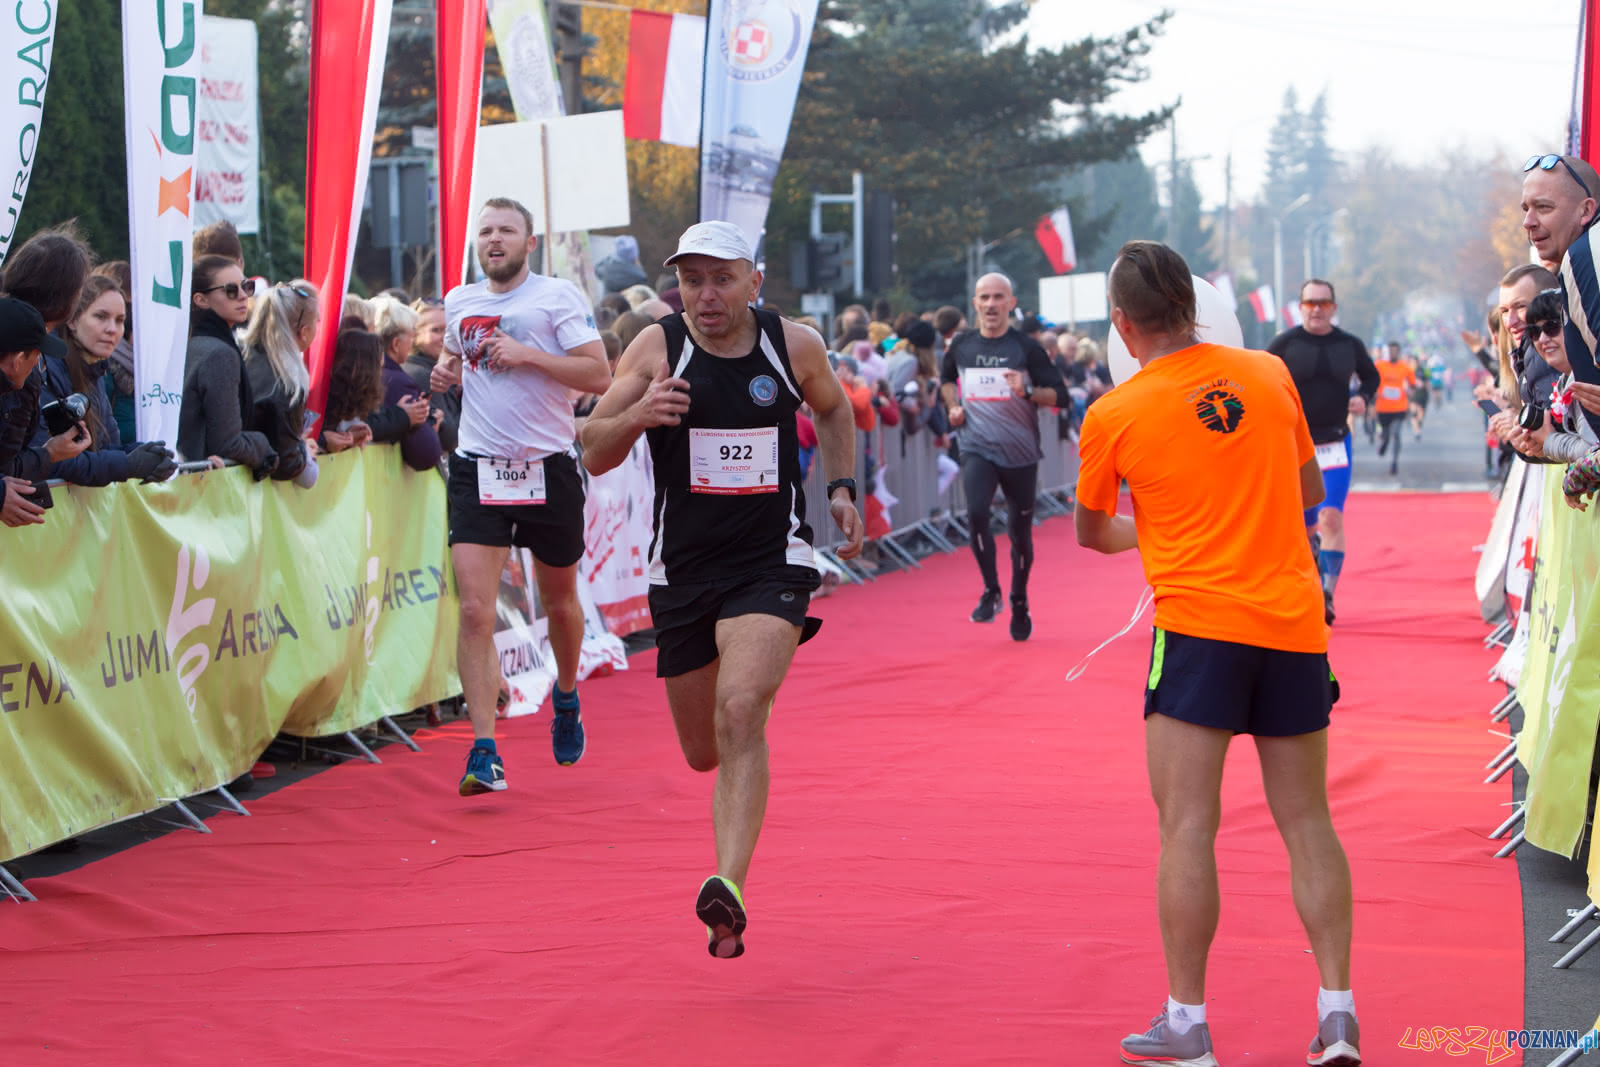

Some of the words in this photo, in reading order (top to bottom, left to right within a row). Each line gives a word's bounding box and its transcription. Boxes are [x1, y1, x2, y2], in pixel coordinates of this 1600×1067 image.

[719, 445, 753, 461] 922
[495, 469, 527, 481] 1004
[101, 628, 170, 688] JUMI
[214, 603, 299, 662] ARENA
